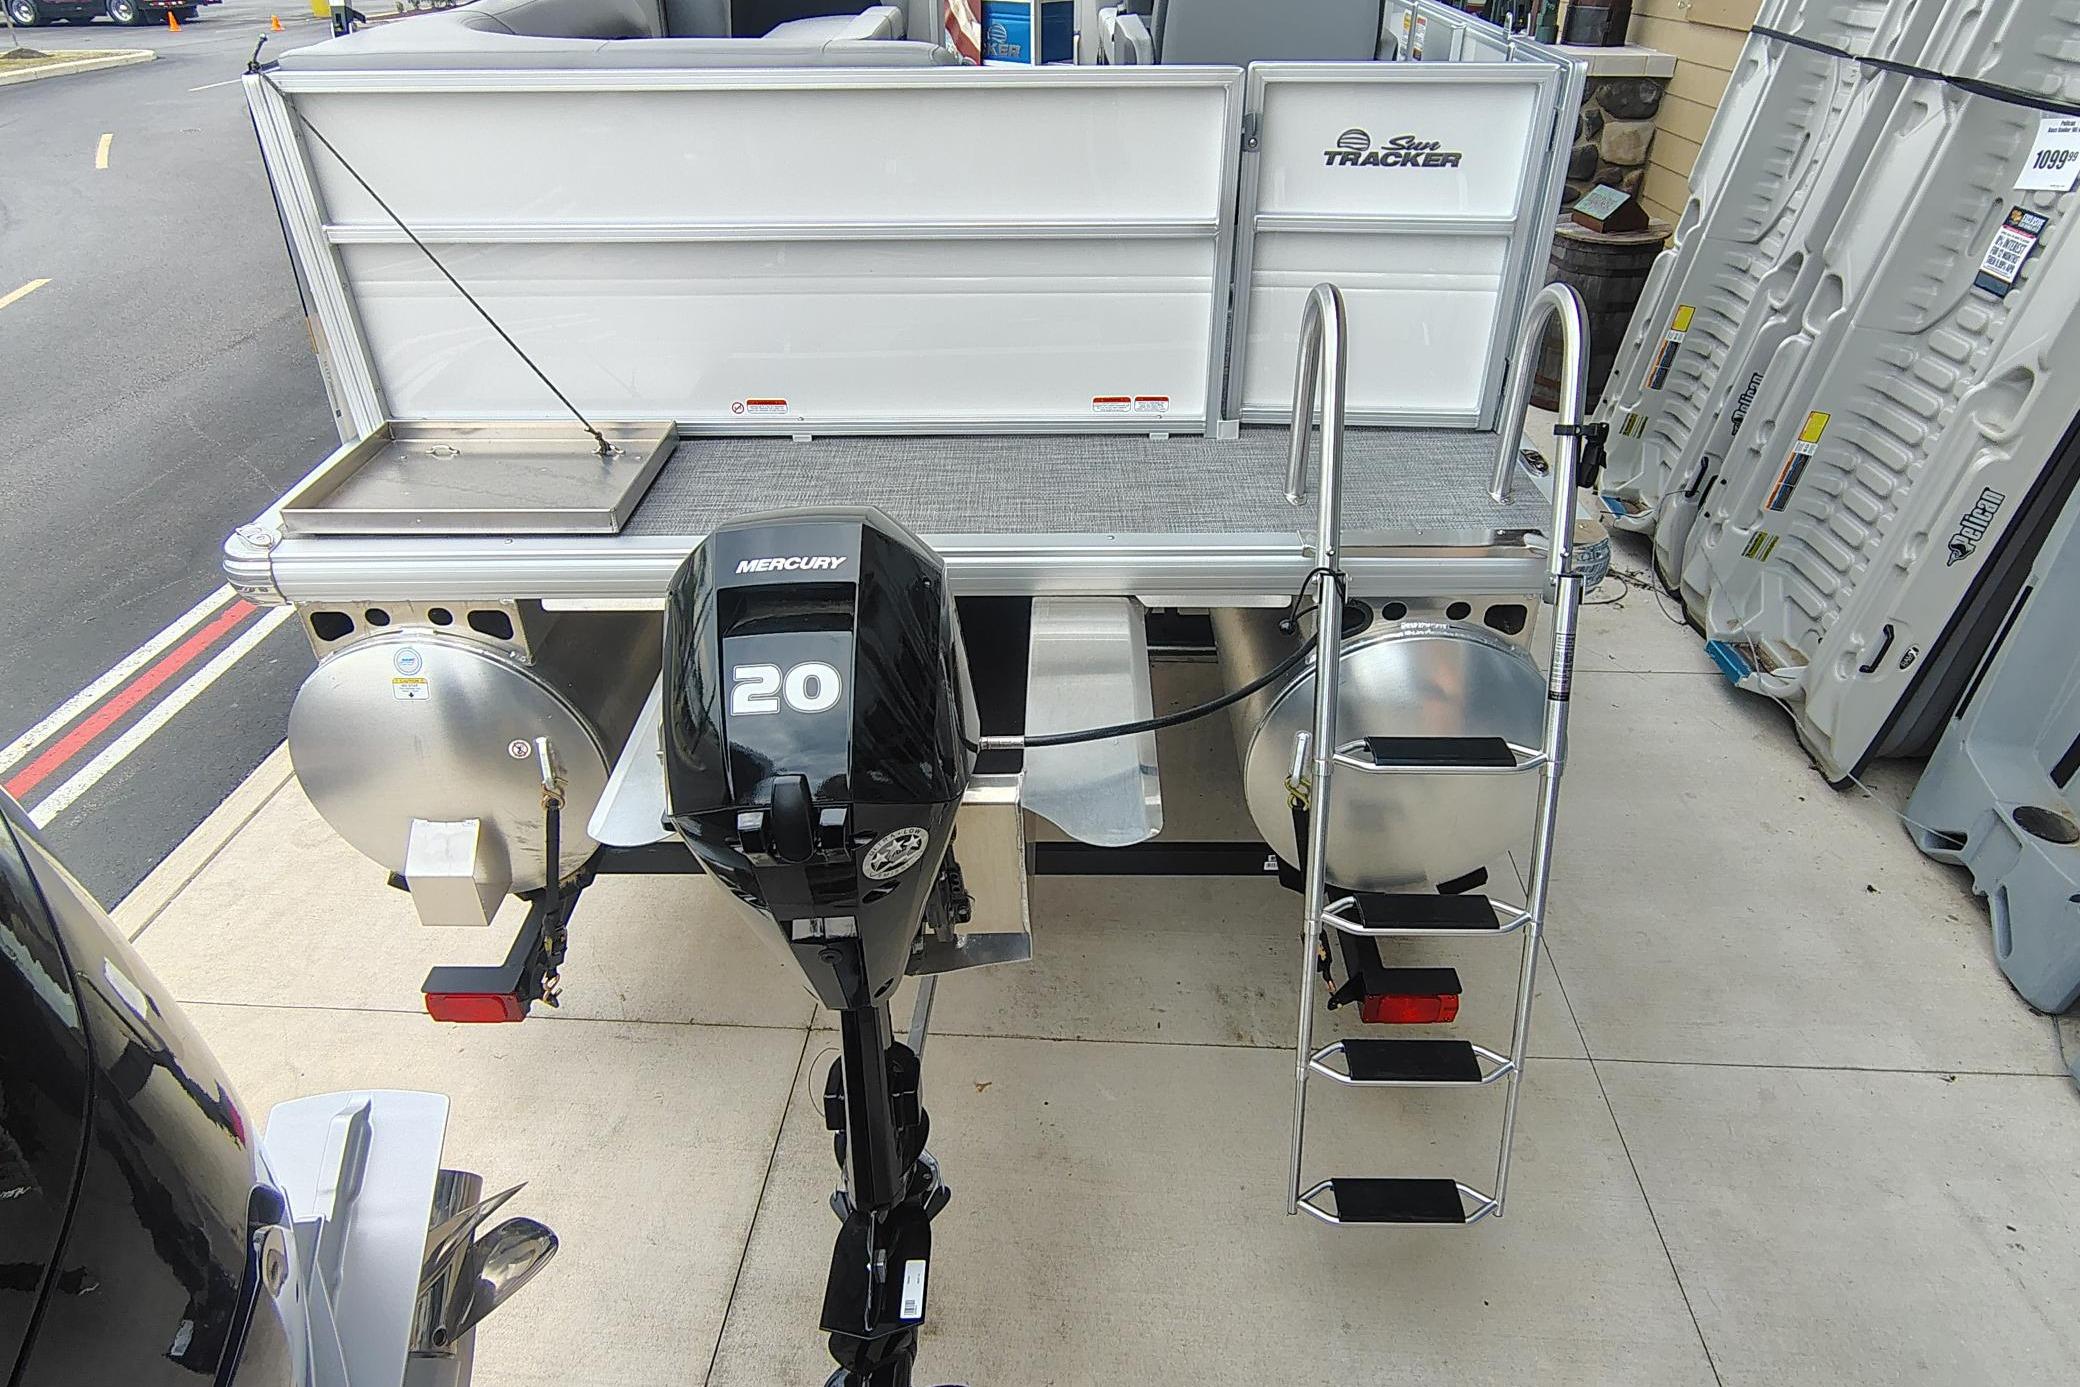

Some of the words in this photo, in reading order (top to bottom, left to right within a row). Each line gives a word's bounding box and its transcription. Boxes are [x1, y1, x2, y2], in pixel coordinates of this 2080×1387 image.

[1381, 135, 1441, 152] Sun
[1323, 151, 1462, 168] TRACKER
[1948, 487, 2006, 552] Pelican
[735, 556, 847, 574] MERCURY
[730, 661, 842, 717] 20
